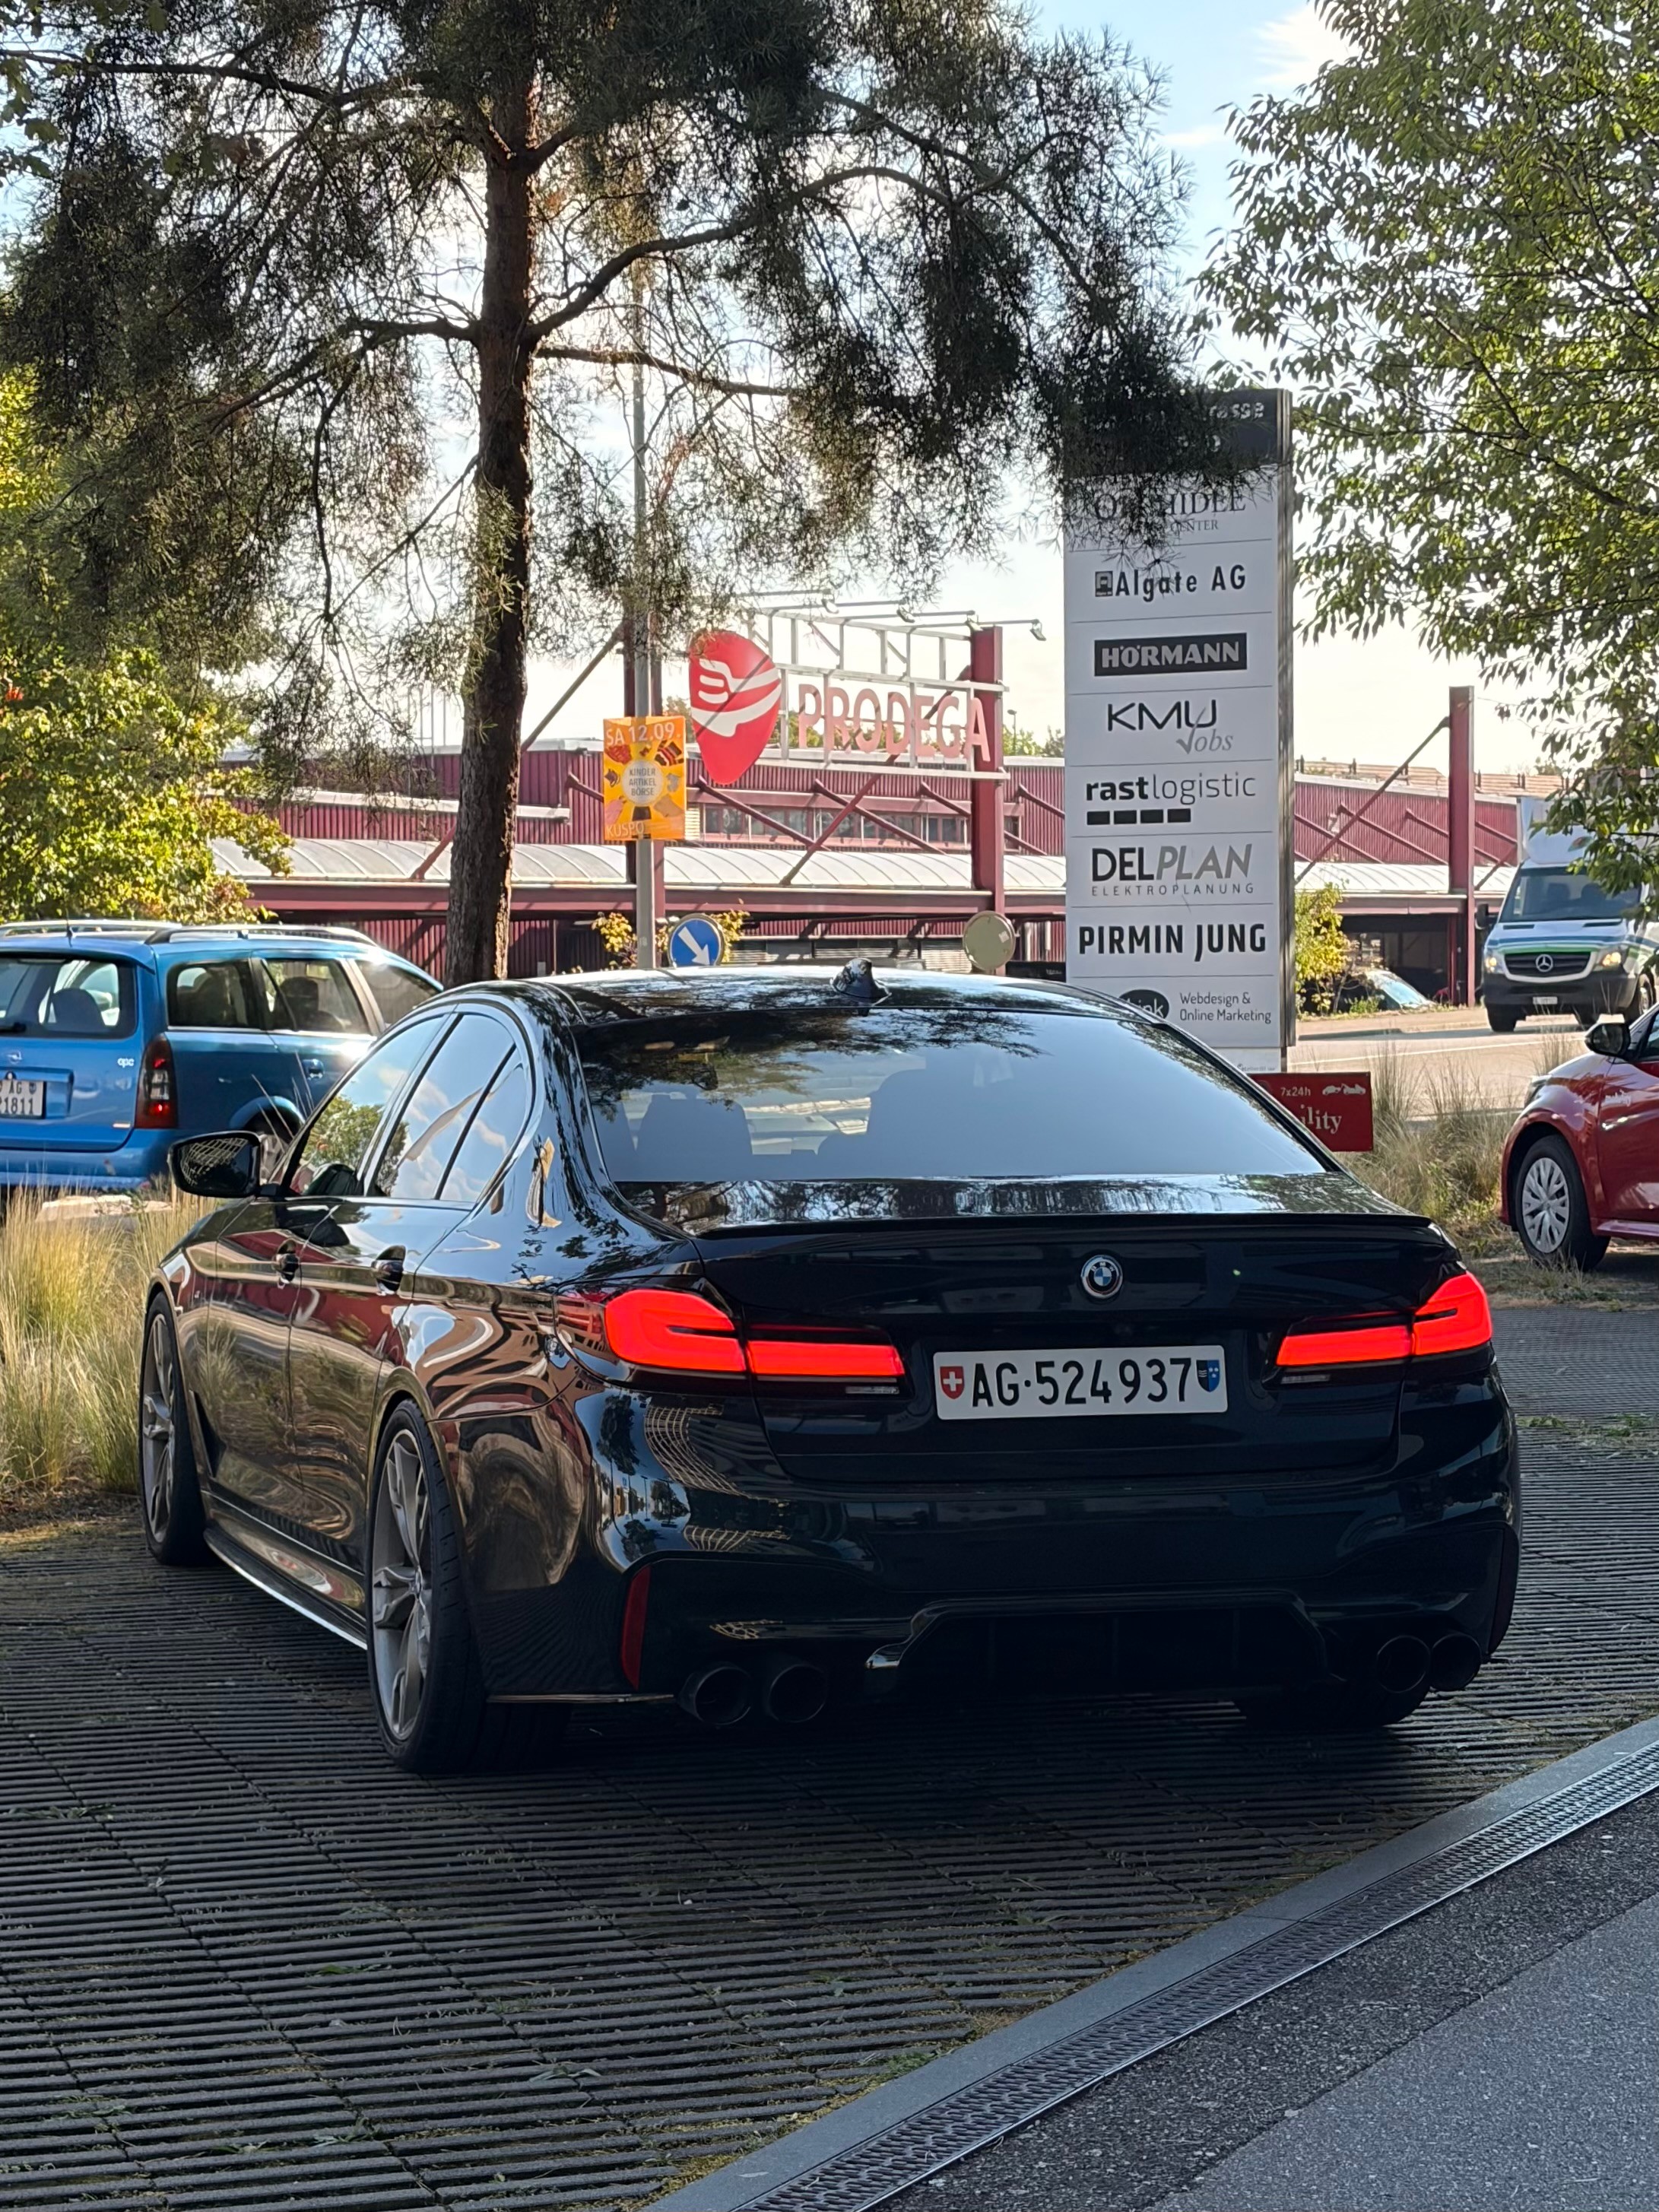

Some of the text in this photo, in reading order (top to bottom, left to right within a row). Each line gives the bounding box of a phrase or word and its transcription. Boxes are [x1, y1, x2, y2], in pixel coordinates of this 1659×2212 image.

[1115, 564, 1246, 602] Algate AG
[1102, 640, 1239, 668] HÖRMANN
[798, 683, 991, 762] PRODEGA
[1107, 699, 1217, 732] KMU
[606, 722, 681, 746] SA 12.09.
[630, 768, 656, 776] KINDER
[629, 778, 657, 786] ARTIKEL
[607, 821, 645, 836] KUSPO
[1092, 883, 1254, 897] ELEKTROPLANUNG
[1079, 923, 1266, 962] PIRMIN JUNG
[1179, 992, 1240, 1008] Webdesign
[1242, 992, 1251, 1004] &
[1179, 1008, 1272, 1024] Online Marketing
[8, 1080, 22, 1094] AG
[1280, 1087, 1312, 1096] 7x24h
[0, 1096, 33, 1115] 1811
